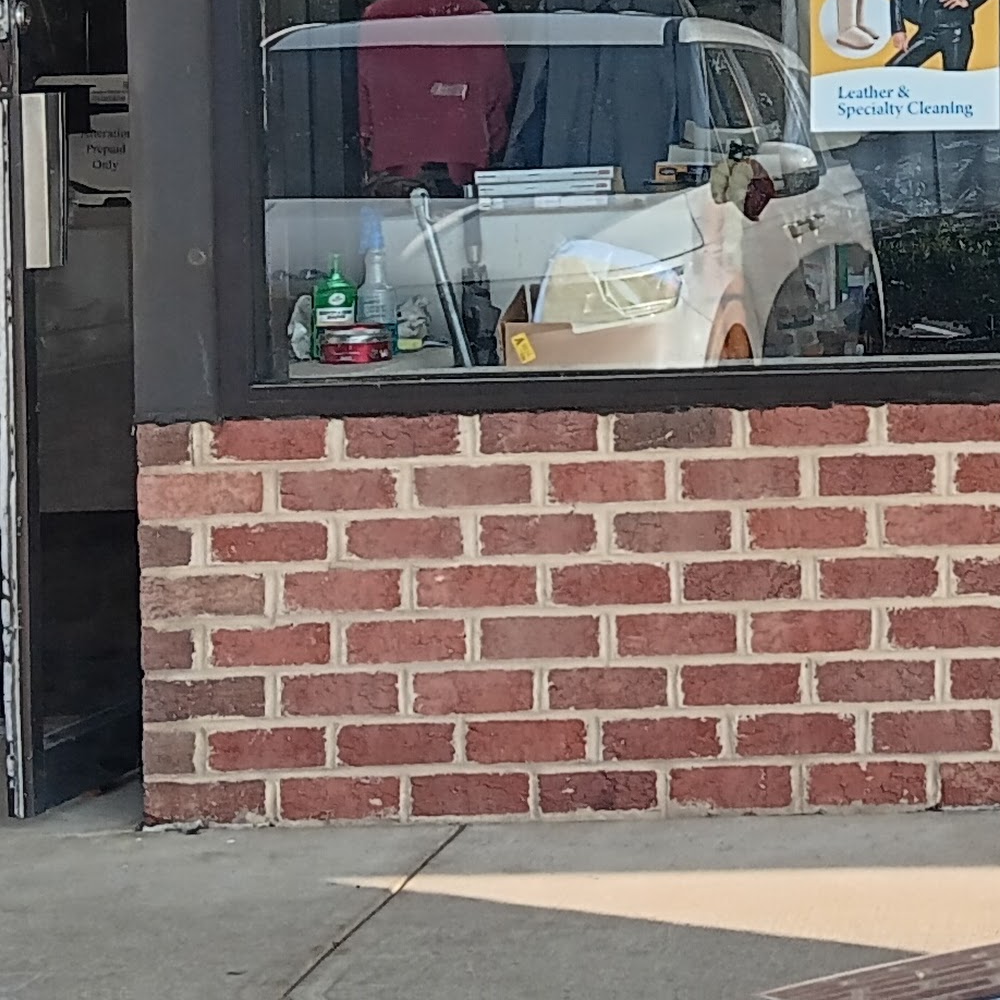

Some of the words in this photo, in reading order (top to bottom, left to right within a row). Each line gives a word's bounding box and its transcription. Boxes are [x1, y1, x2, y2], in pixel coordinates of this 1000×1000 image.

[838, 85, 894, 99] Leather
[898, 85, 910, 98] &
[838, 101, 903, 119] Specialty
[907, 101, 974, 118] Cleaning
[92, 160, 119, 172] Only
